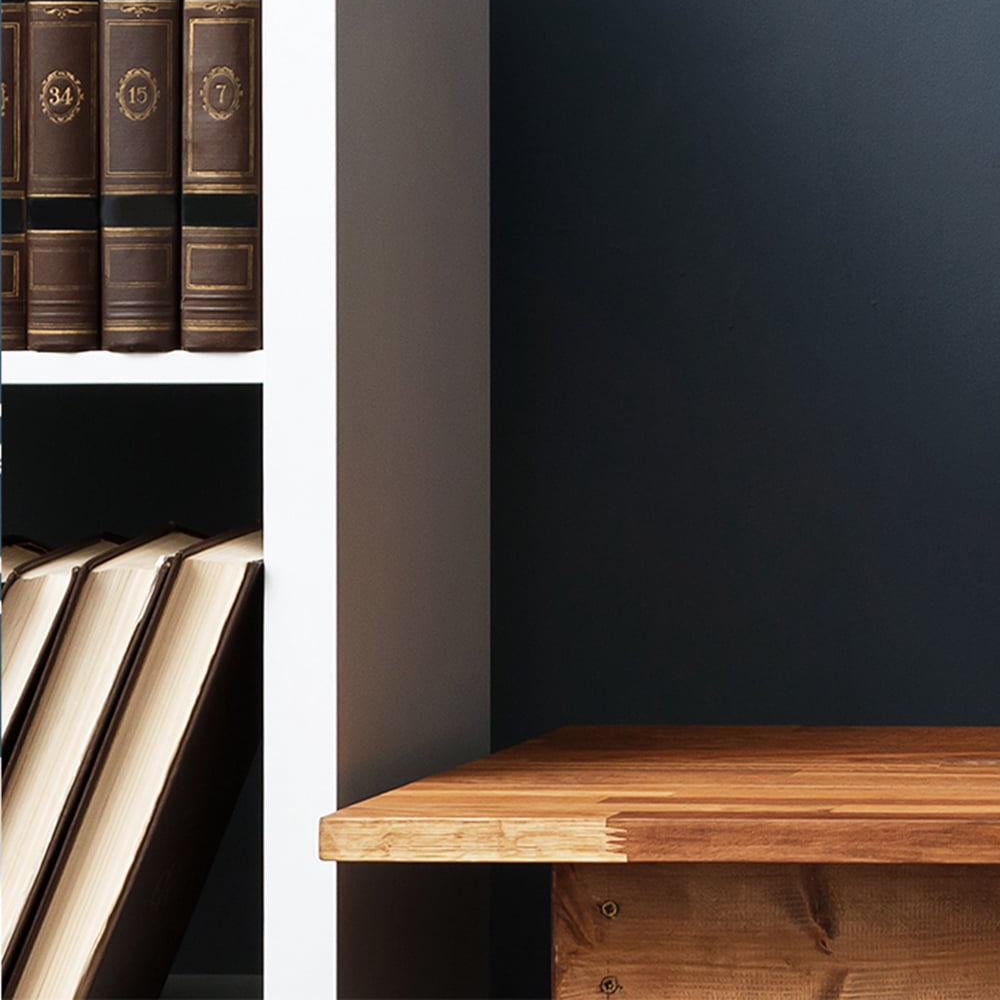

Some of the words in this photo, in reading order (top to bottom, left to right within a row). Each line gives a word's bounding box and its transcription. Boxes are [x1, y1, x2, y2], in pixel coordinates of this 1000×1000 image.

[49, 86, 74, 106] 34
[127, 86, 148, 105] 15
[215, 84, 227, 104] 7
